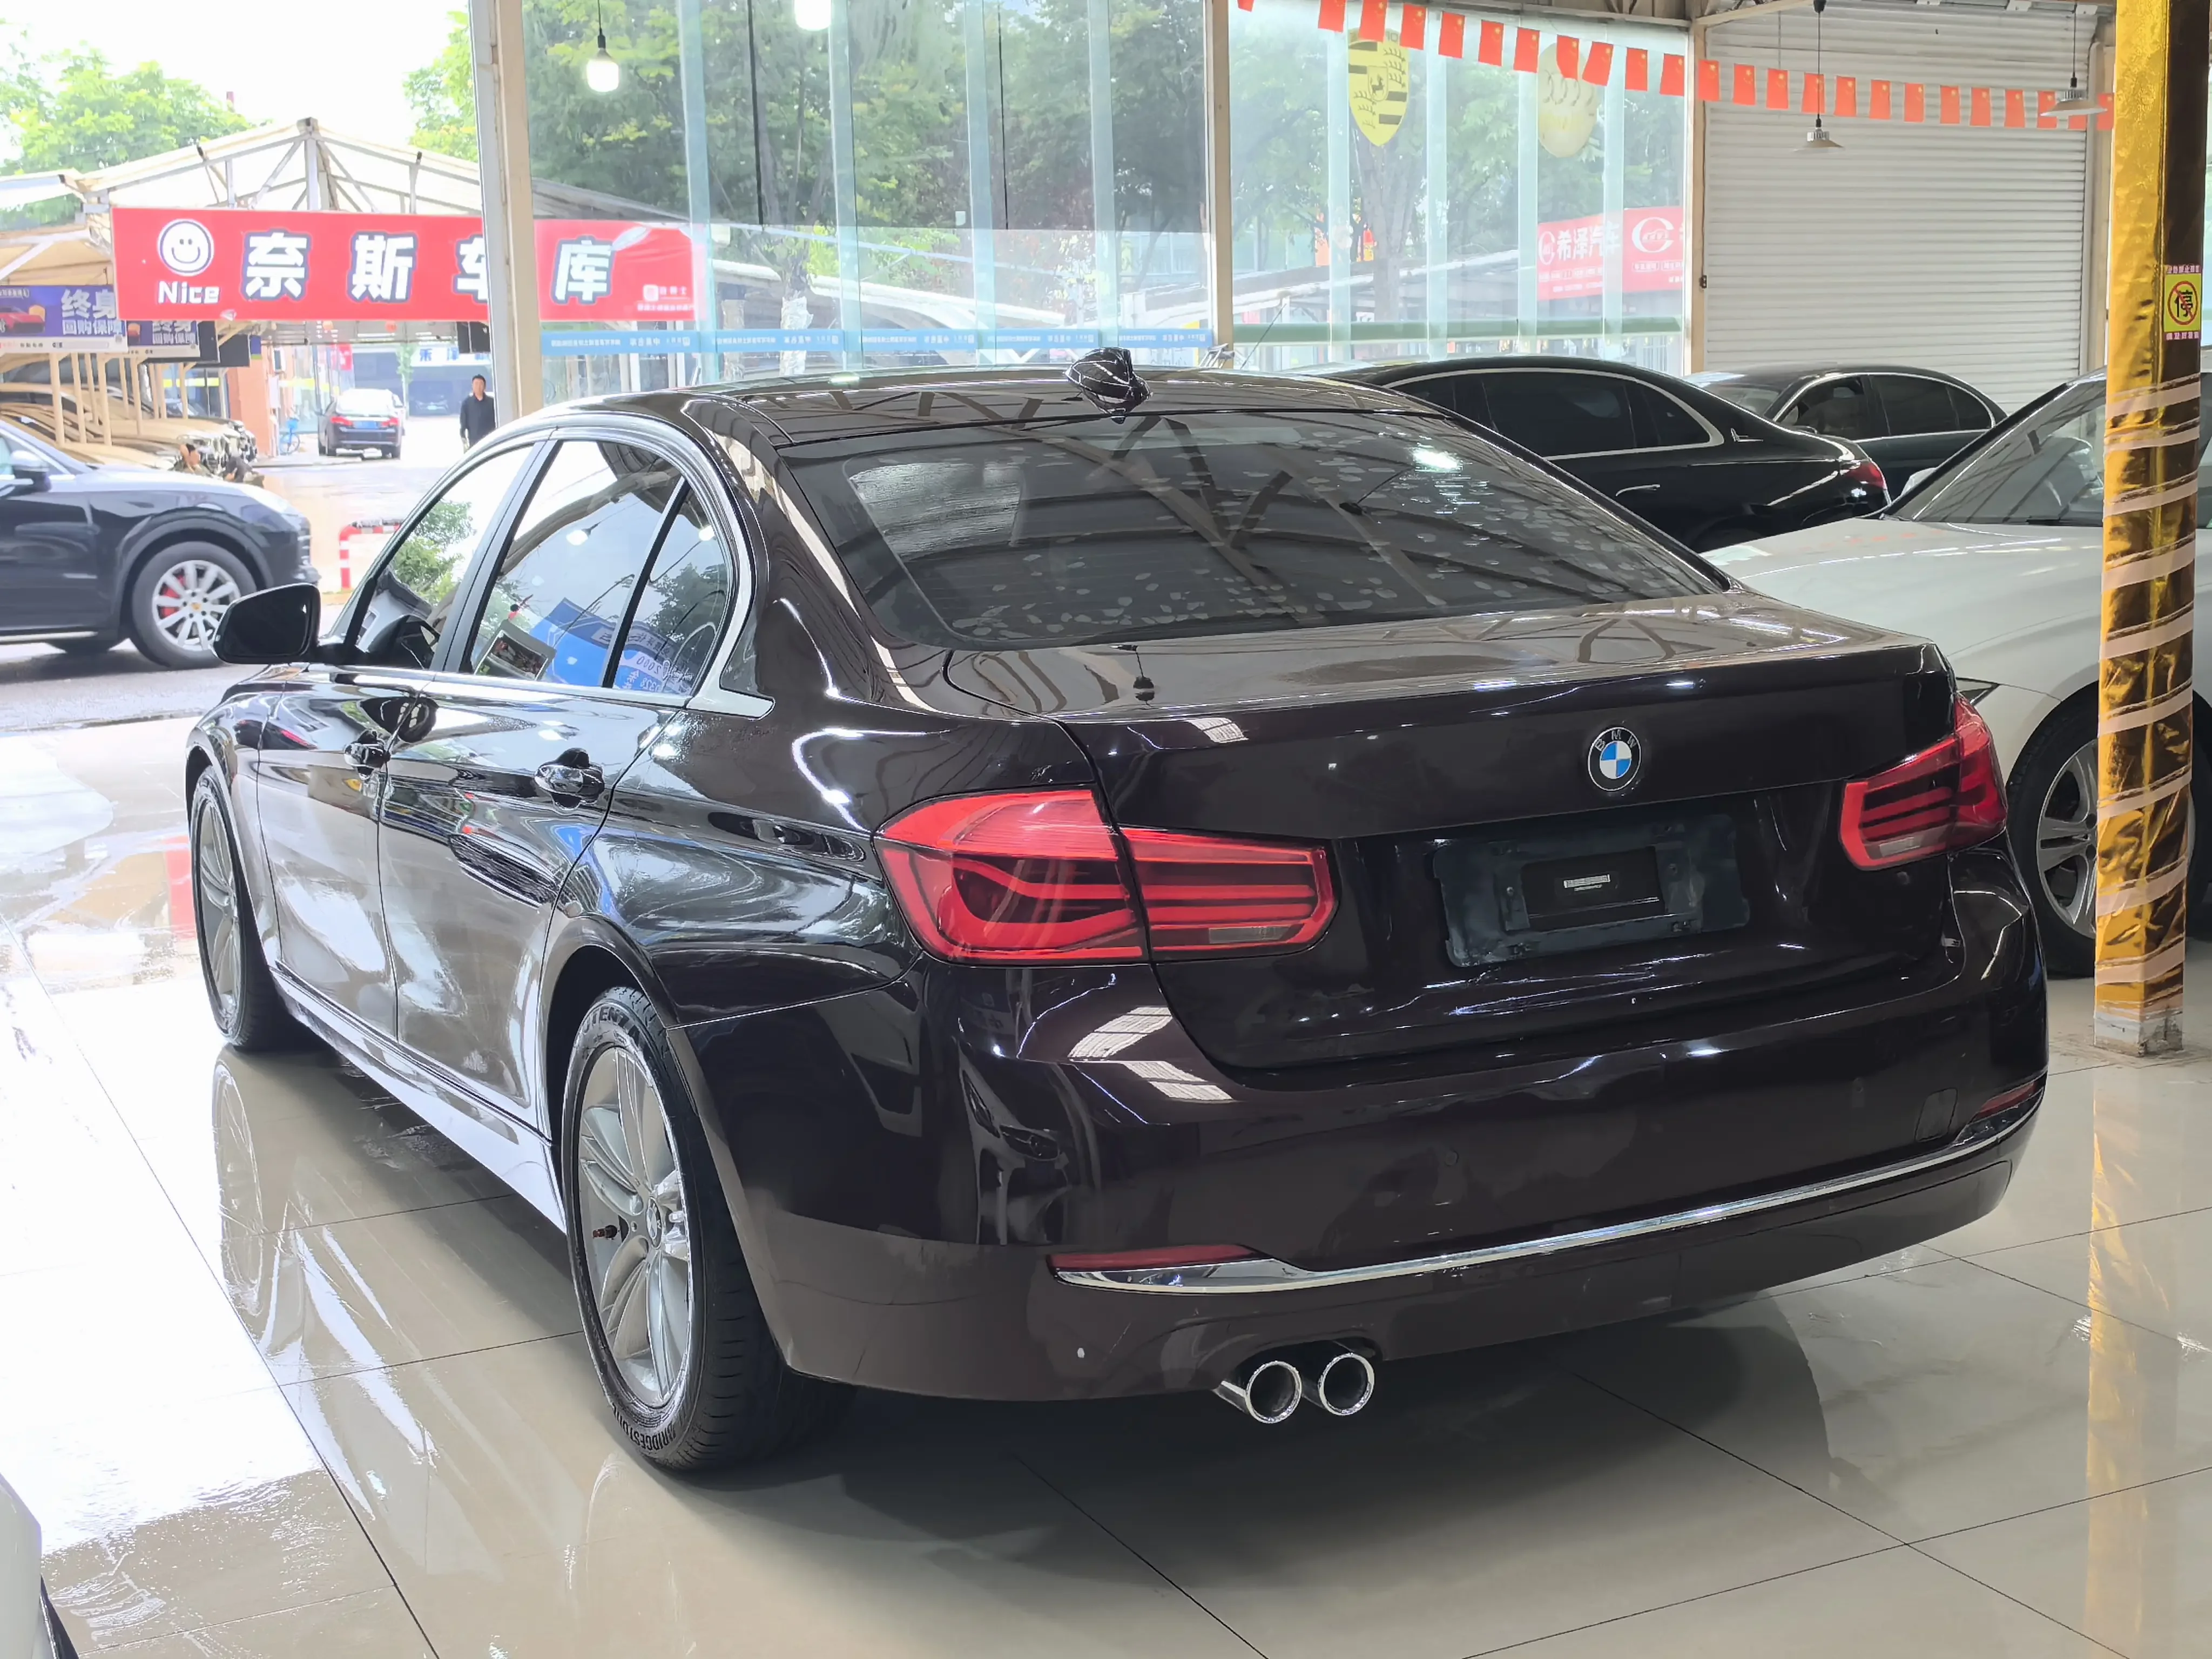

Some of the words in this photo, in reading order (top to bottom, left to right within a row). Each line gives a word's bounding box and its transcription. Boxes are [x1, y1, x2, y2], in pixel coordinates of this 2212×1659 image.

[61, 289, 117, 319] 终身
[158, 280, 220, 304] Nice
[1594, 729, 1637, 751] BMW
